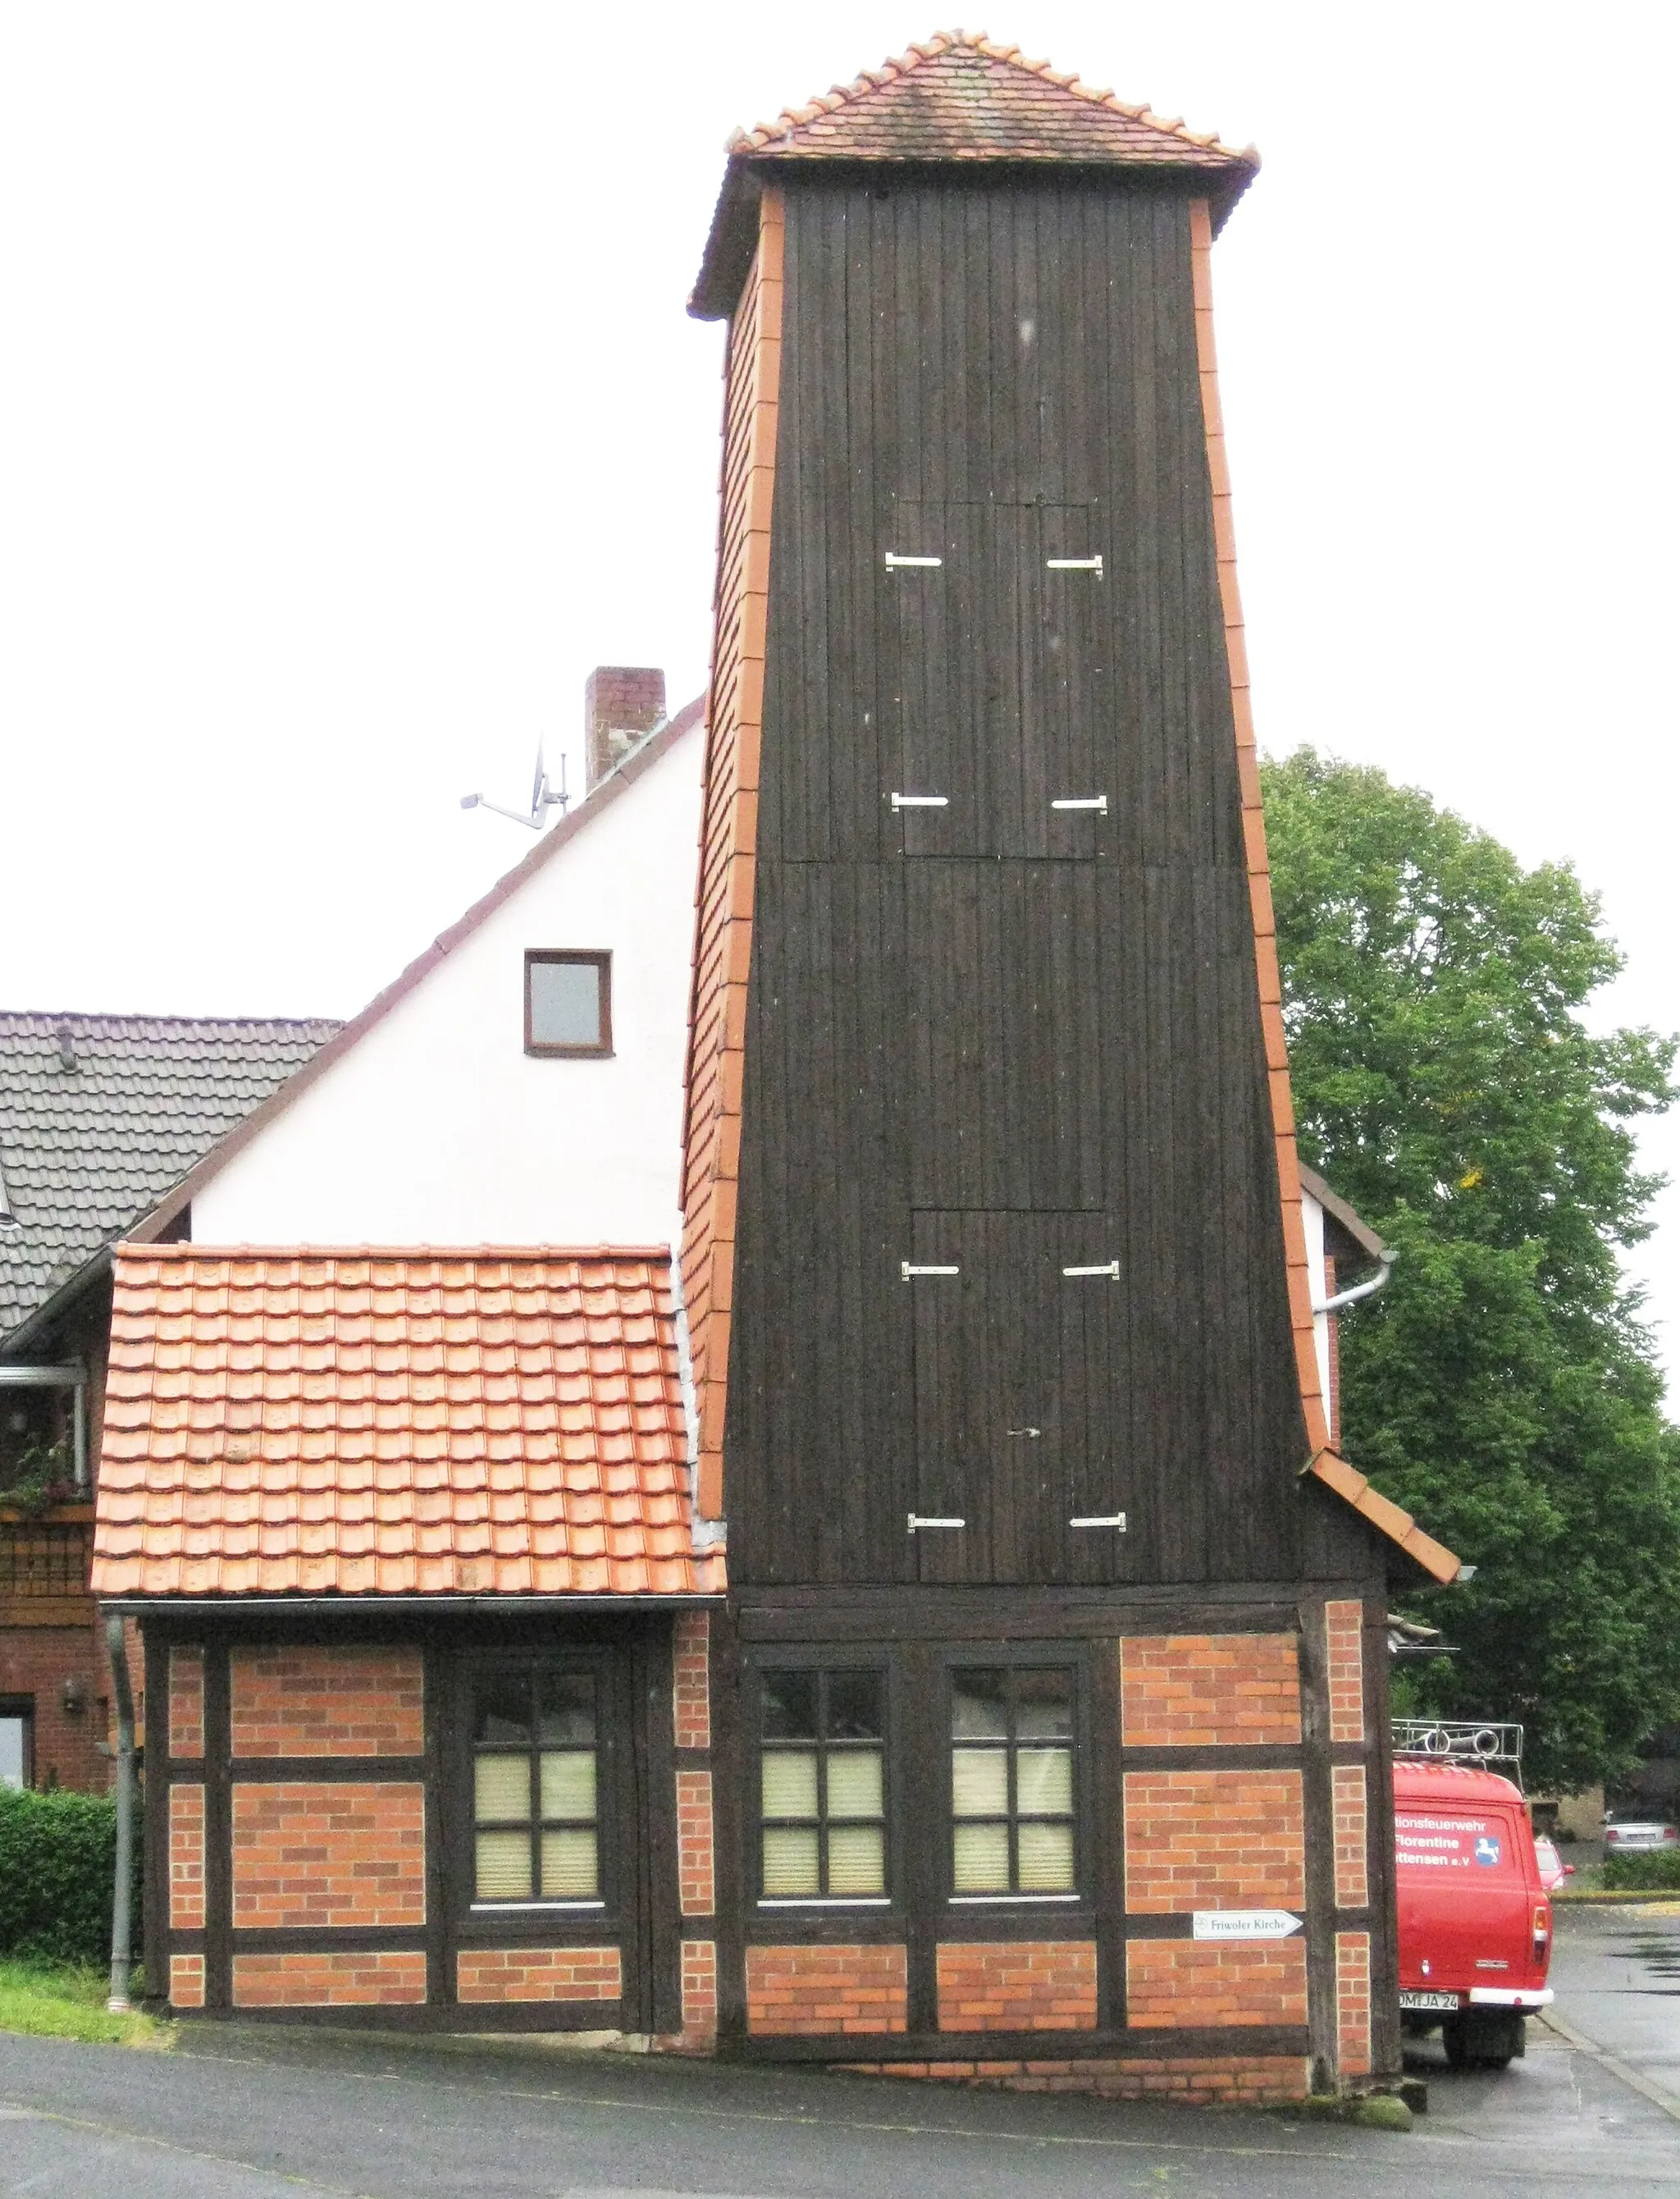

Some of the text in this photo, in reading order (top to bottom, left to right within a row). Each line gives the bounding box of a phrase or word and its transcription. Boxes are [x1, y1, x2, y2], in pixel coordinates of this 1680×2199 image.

[1211, 1918, 1286, 1931] Friwoler Kirche
[1442, 1996, 1457, 2008] 24
